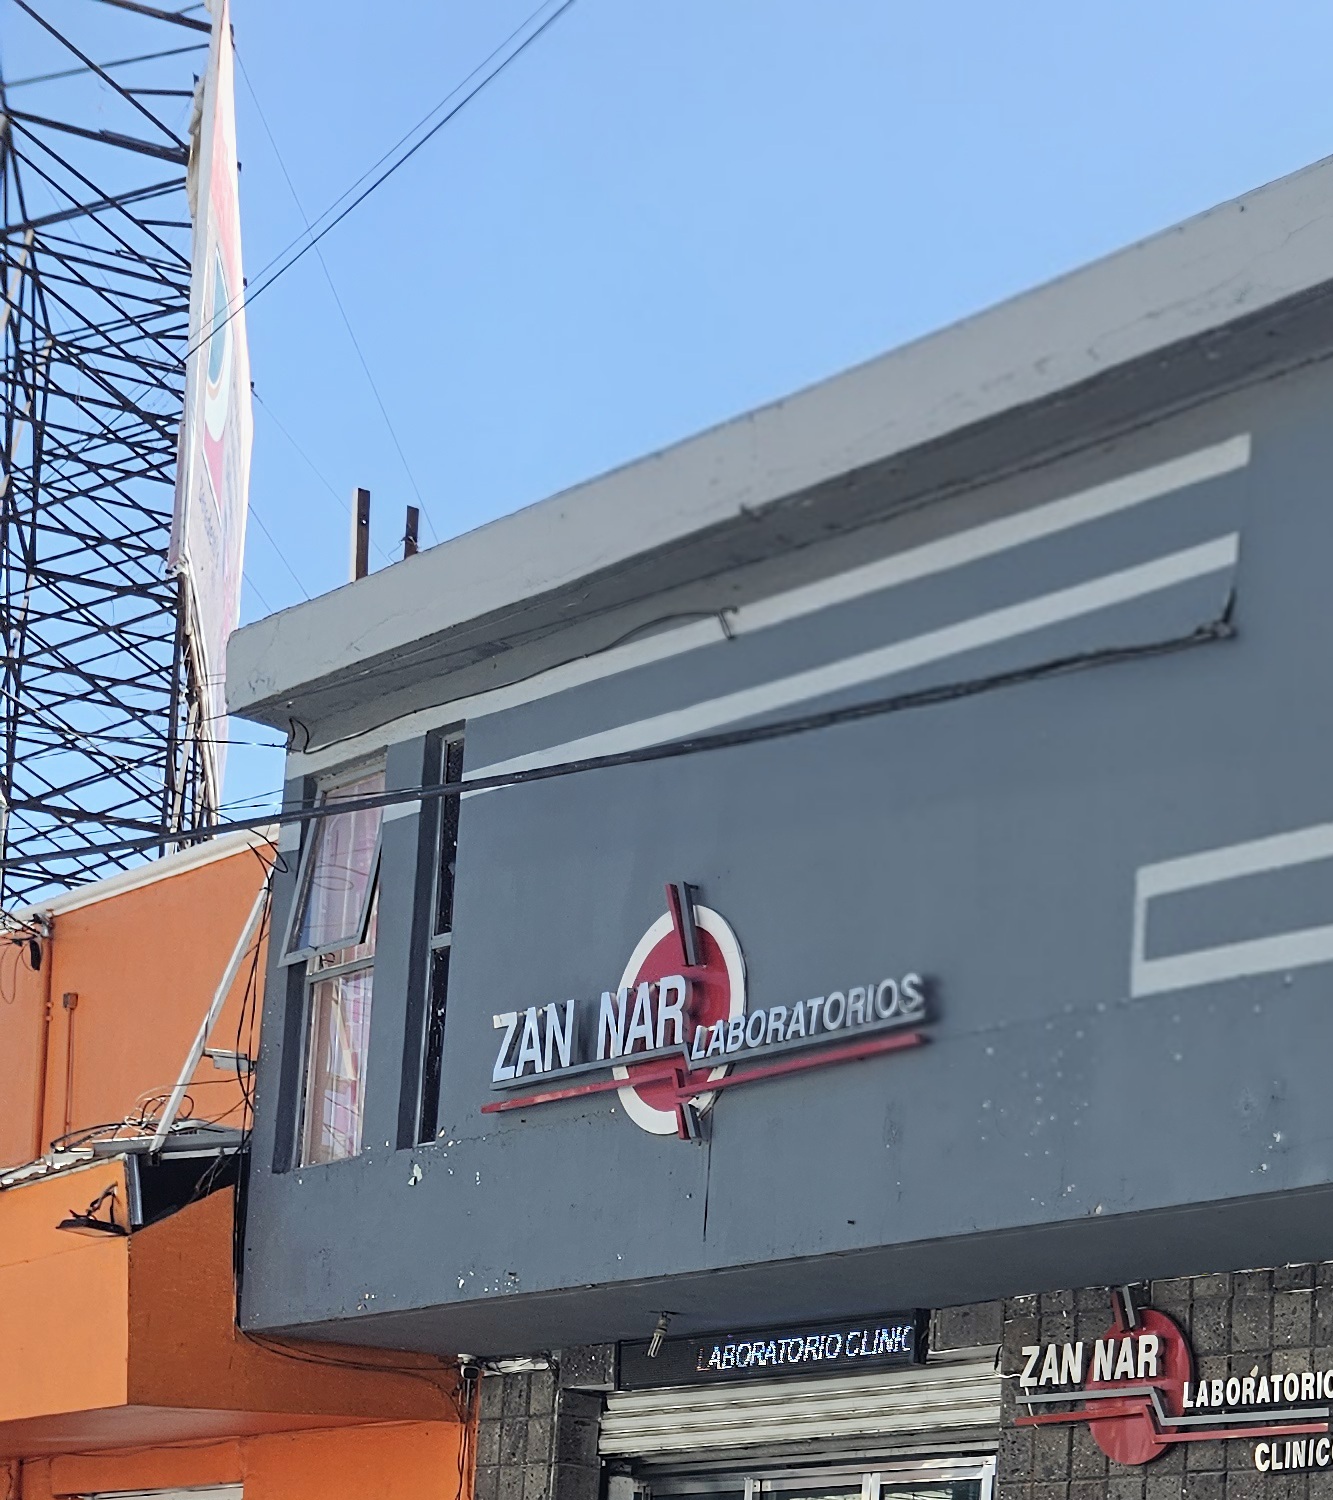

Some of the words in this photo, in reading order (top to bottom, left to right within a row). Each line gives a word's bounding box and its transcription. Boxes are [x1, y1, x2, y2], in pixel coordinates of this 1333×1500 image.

[493, 1000, 575, 1083] ZAN
[597, 975, 687, 1060] NAR
[691, 972, 926, 1061] LABORATORIOS
[1019, 1344, 1082, 1388] ZAN
[1094, 1334, 1163, 1382] NAR
